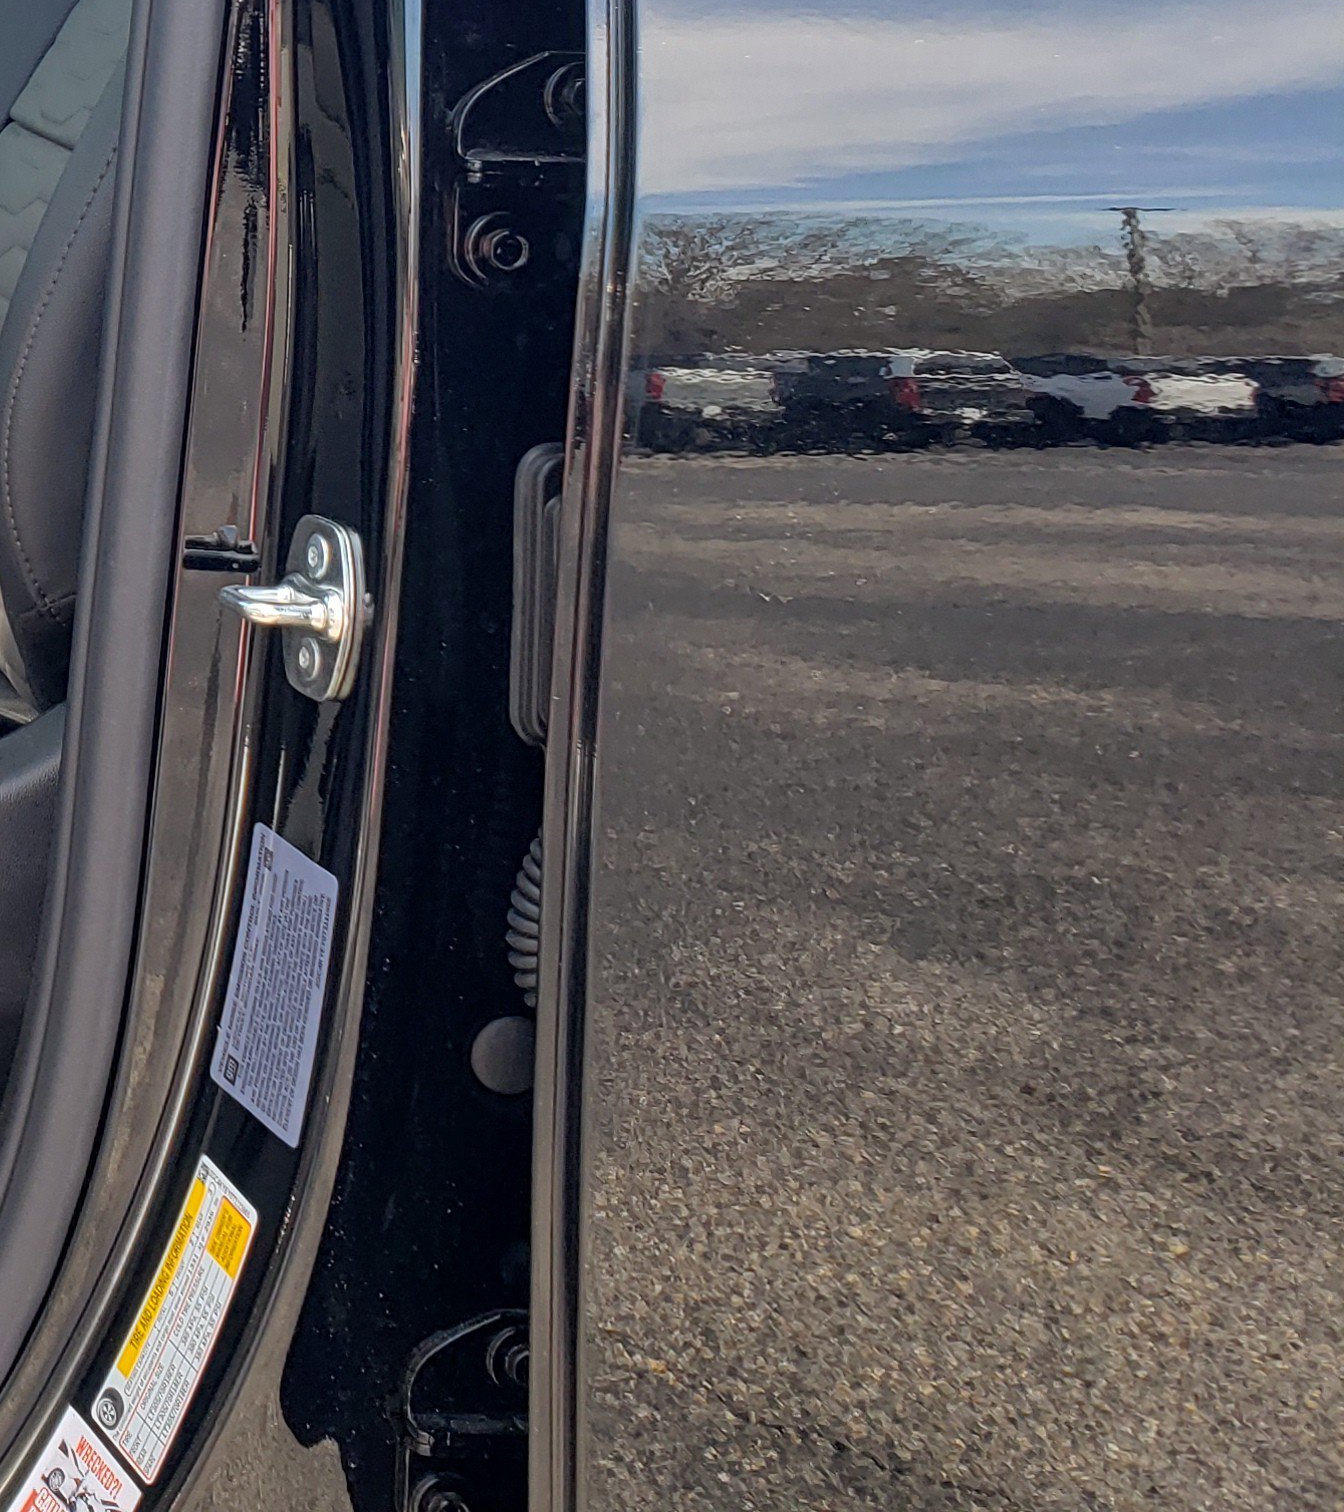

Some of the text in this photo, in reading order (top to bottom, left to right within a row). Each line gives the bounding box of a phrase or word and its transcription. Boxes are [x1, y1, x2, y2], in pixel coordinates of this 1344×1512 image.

[128, 1209, 193, 1351] TIRE AND LOADING INFORMATION
[75, 1435, 123, 1500] WRECKED?!
